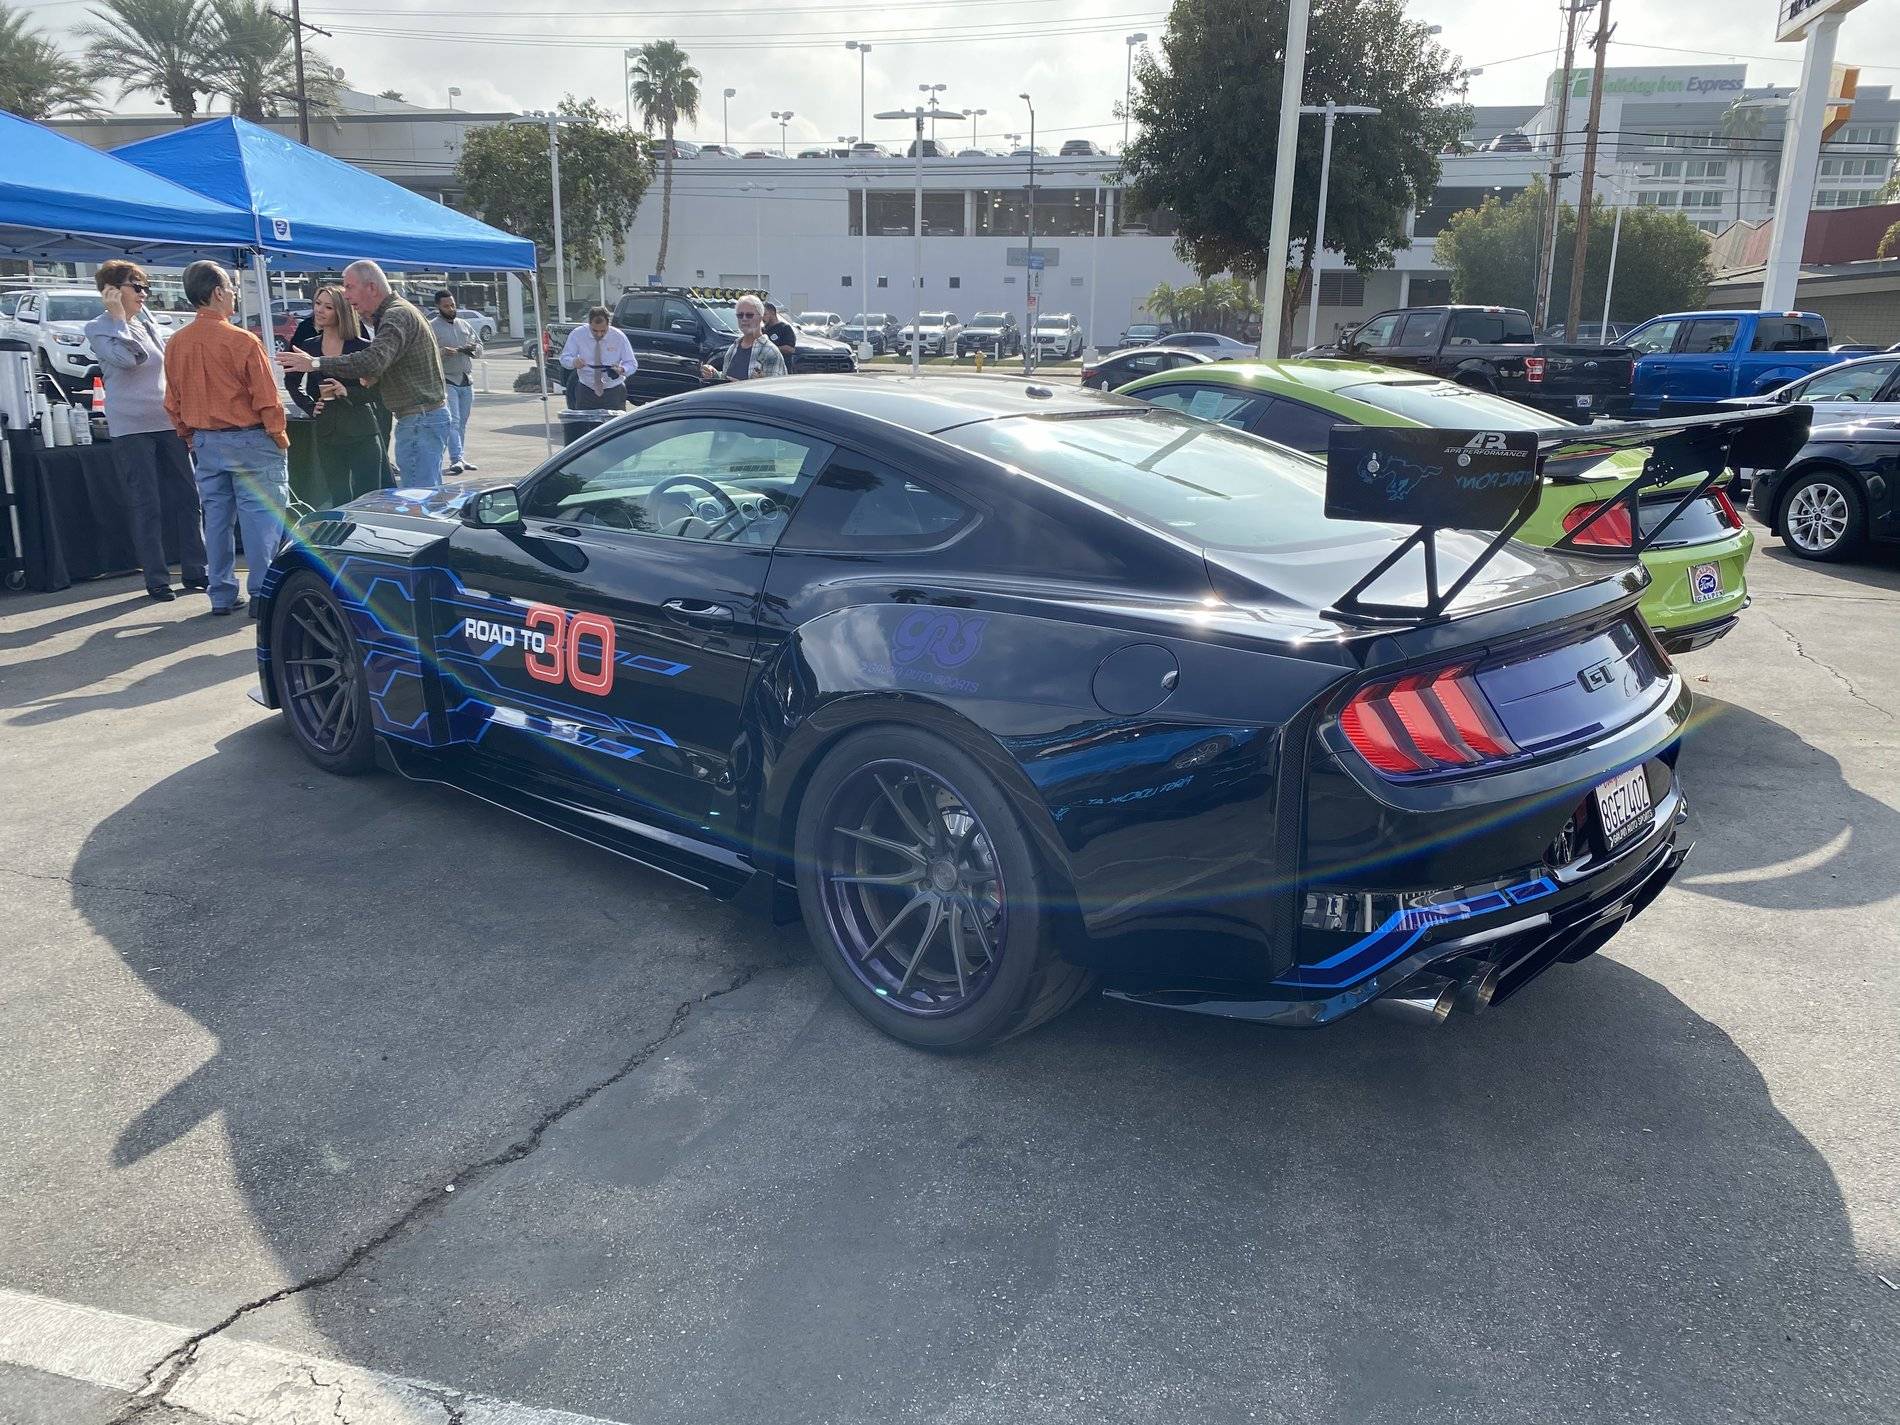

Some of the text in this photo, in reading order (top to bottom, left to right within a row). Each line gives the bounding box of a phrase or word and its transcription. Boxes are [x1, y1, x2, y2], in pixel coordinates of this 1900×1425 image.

[1686, 76, 1745, 94] Express
[1462, 448, 1529, 458] PERFORMANCE
[464, 603, 616, 697] ROAD TO 30
[1577, 657, 1615, 693] GT
[1601, 775, 1650, 833] 8GEZ402
